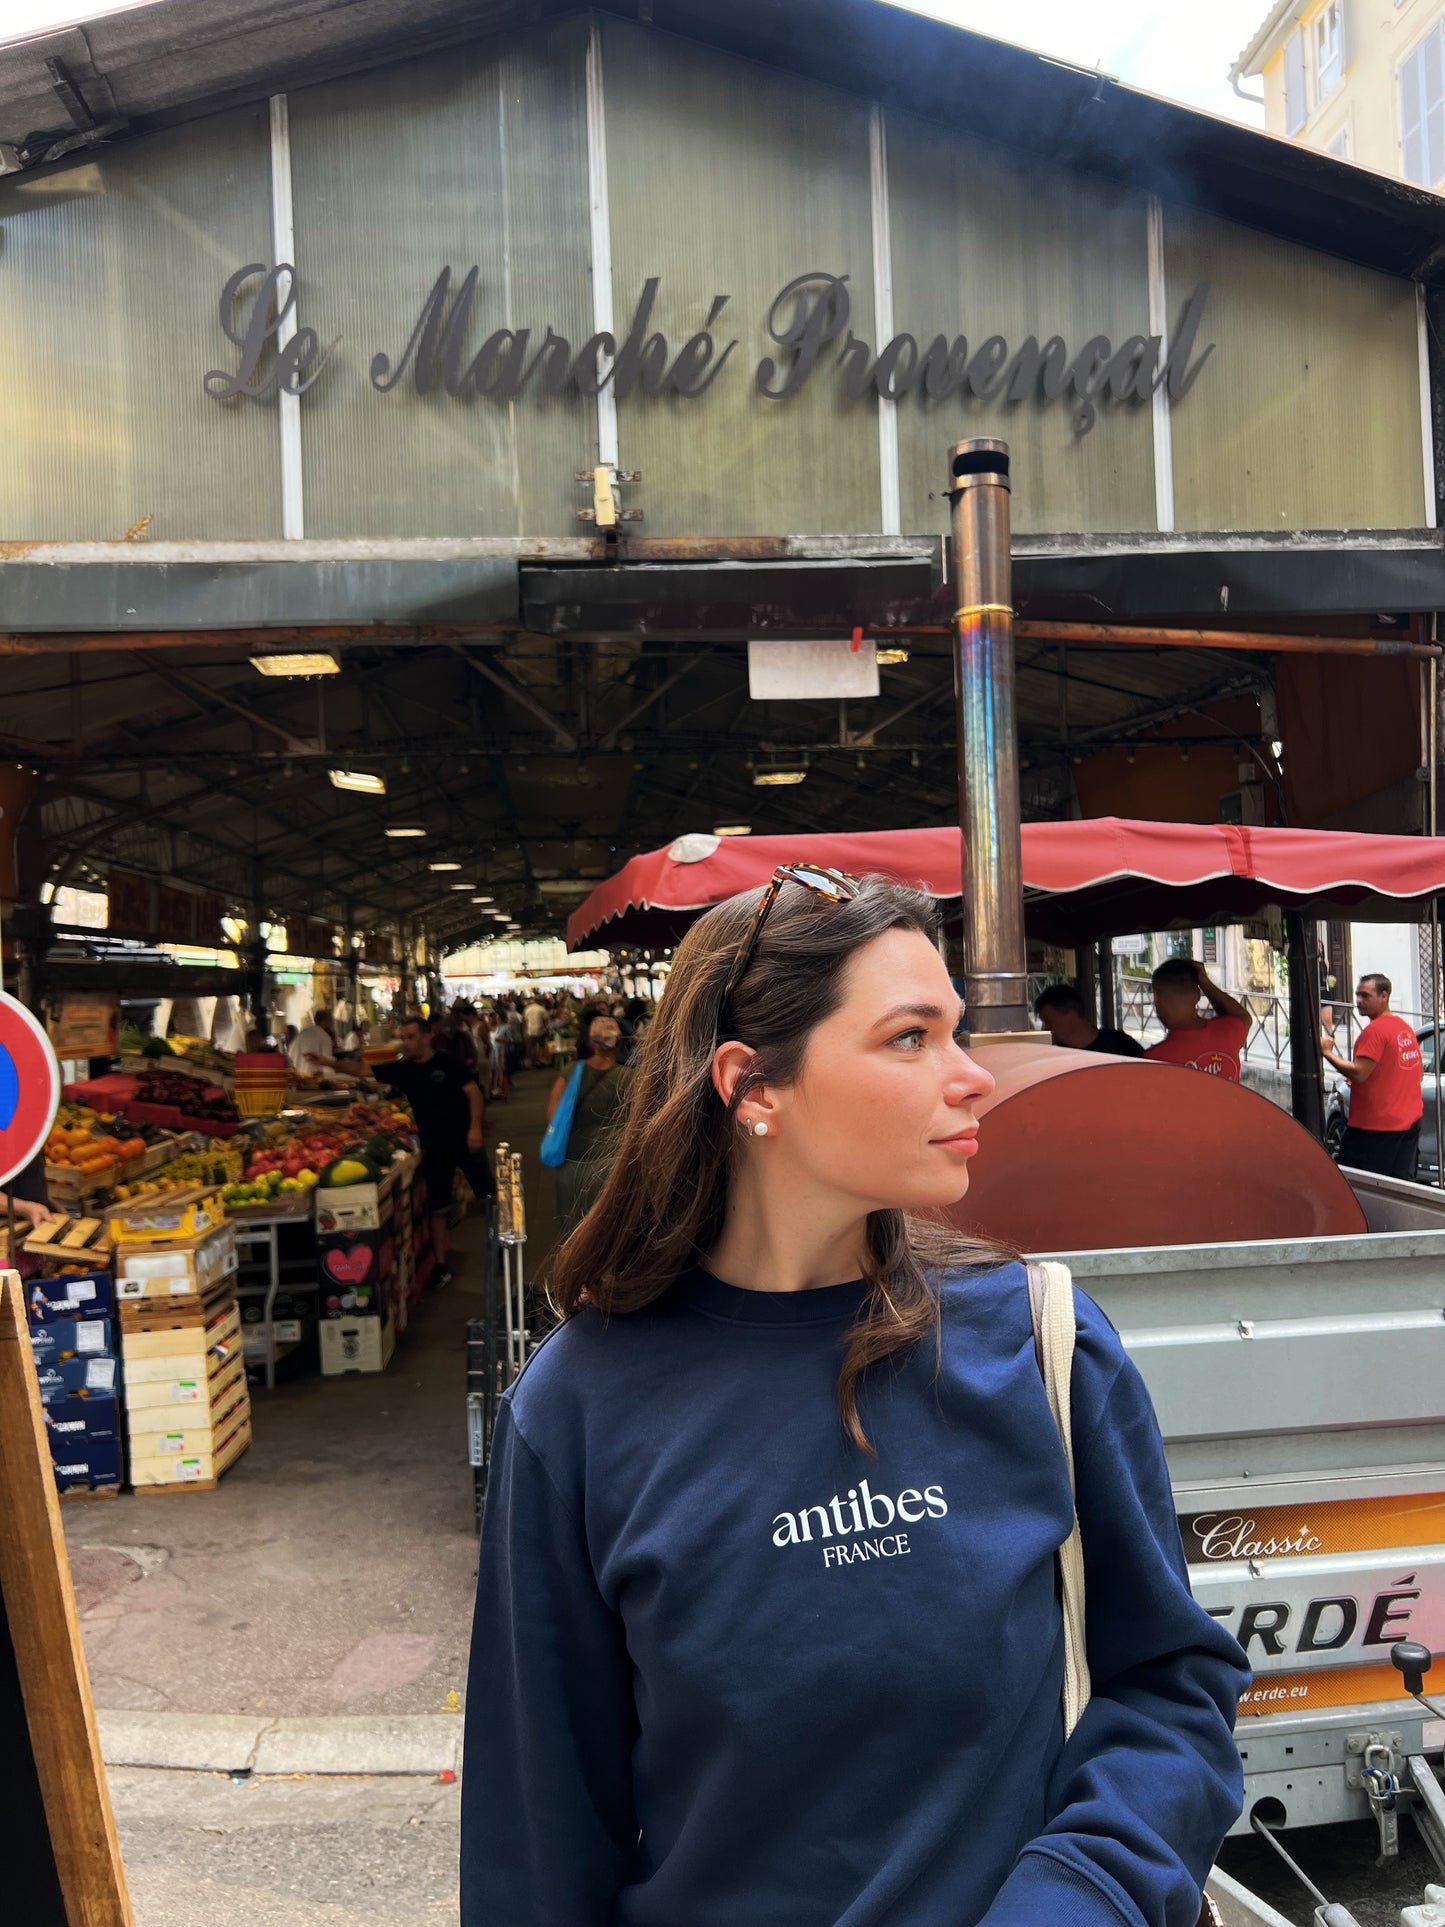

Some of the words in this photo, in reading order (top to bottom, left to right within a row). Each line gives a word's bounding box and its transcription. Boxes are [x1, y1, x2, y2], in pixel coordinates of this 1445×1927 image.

[203, 263, 342, 400] Le
[371, 265, 740, 398] Marché
[757, 272, 1216, 435] Provençal
[772, 1479, 948, 1547] antibes
[1192, 1514, 1322, 1559] Classic
[822, 1533, 911, 1568] FRANCE
